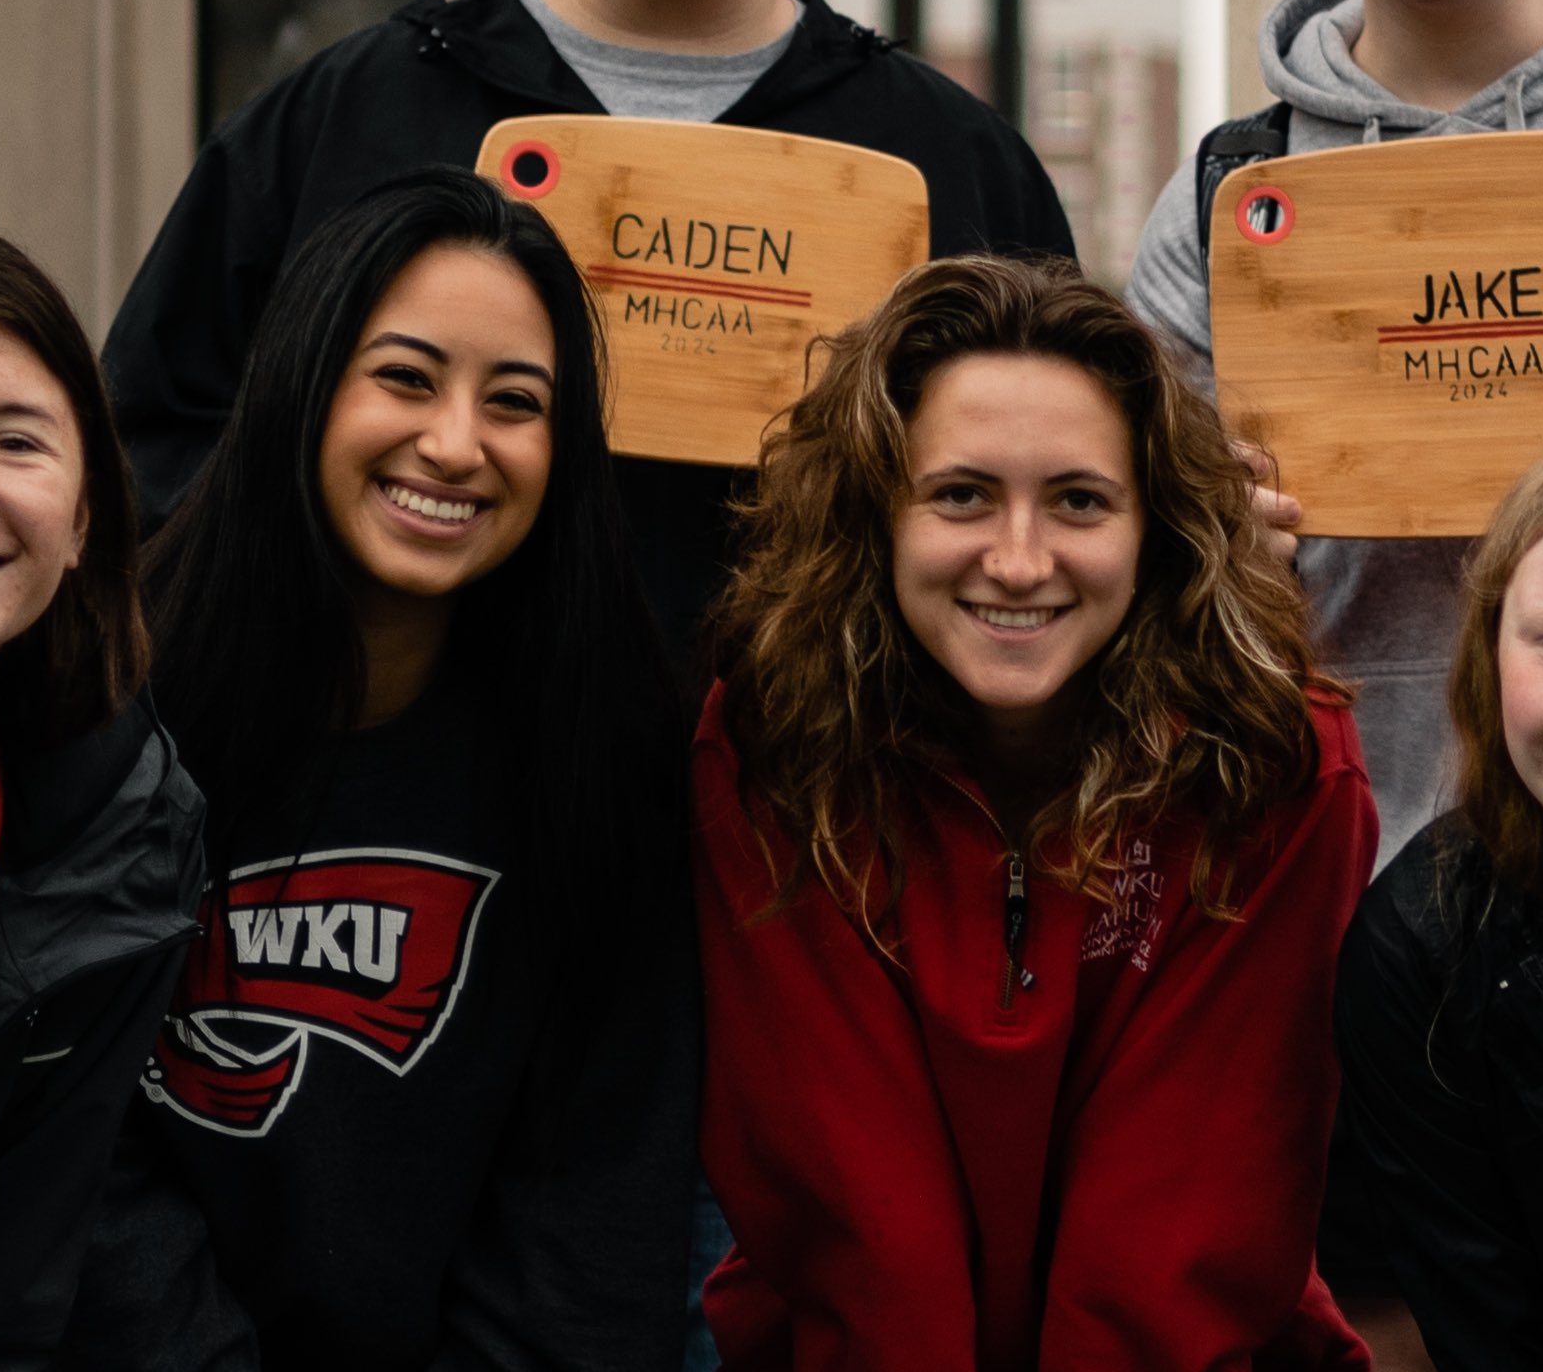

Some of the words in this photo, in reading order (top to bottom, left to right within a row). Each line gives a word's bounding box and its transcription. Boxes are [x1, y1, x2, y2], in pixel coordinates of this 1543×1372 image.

[612, 213, 792, 275] CADEN
[624, 293, 753, 335] MHCAA
[1413, 267, 1543, 324] JAKE
[1404, 343, 1543, 381] MHCAA
[1449, 383, 1508, 402] 2024
[228, 903, 408, 983] WKU
